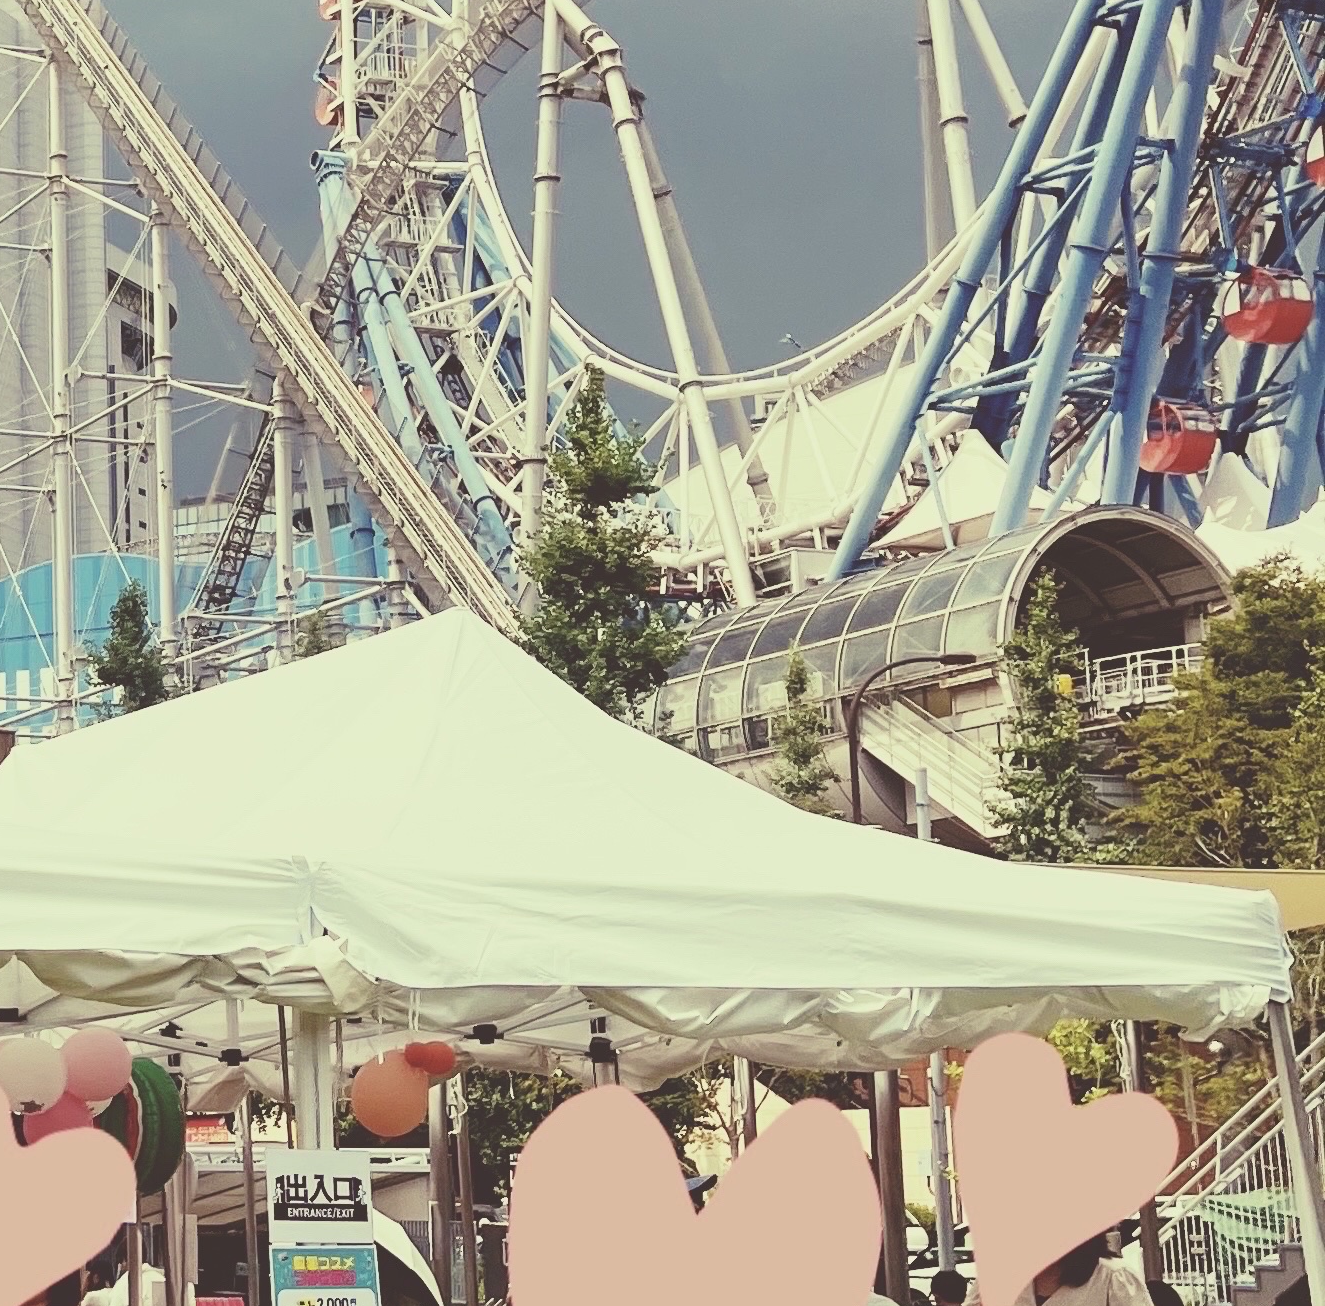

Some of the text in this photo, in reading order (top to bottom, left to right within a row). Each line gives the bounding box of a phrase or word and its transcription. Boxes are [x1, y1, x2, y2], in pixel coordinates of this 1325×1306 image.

[284, 1173, 356, 1204] 出入口
[287, 1207, 355, 1219] ENTRANCE/EXIT
